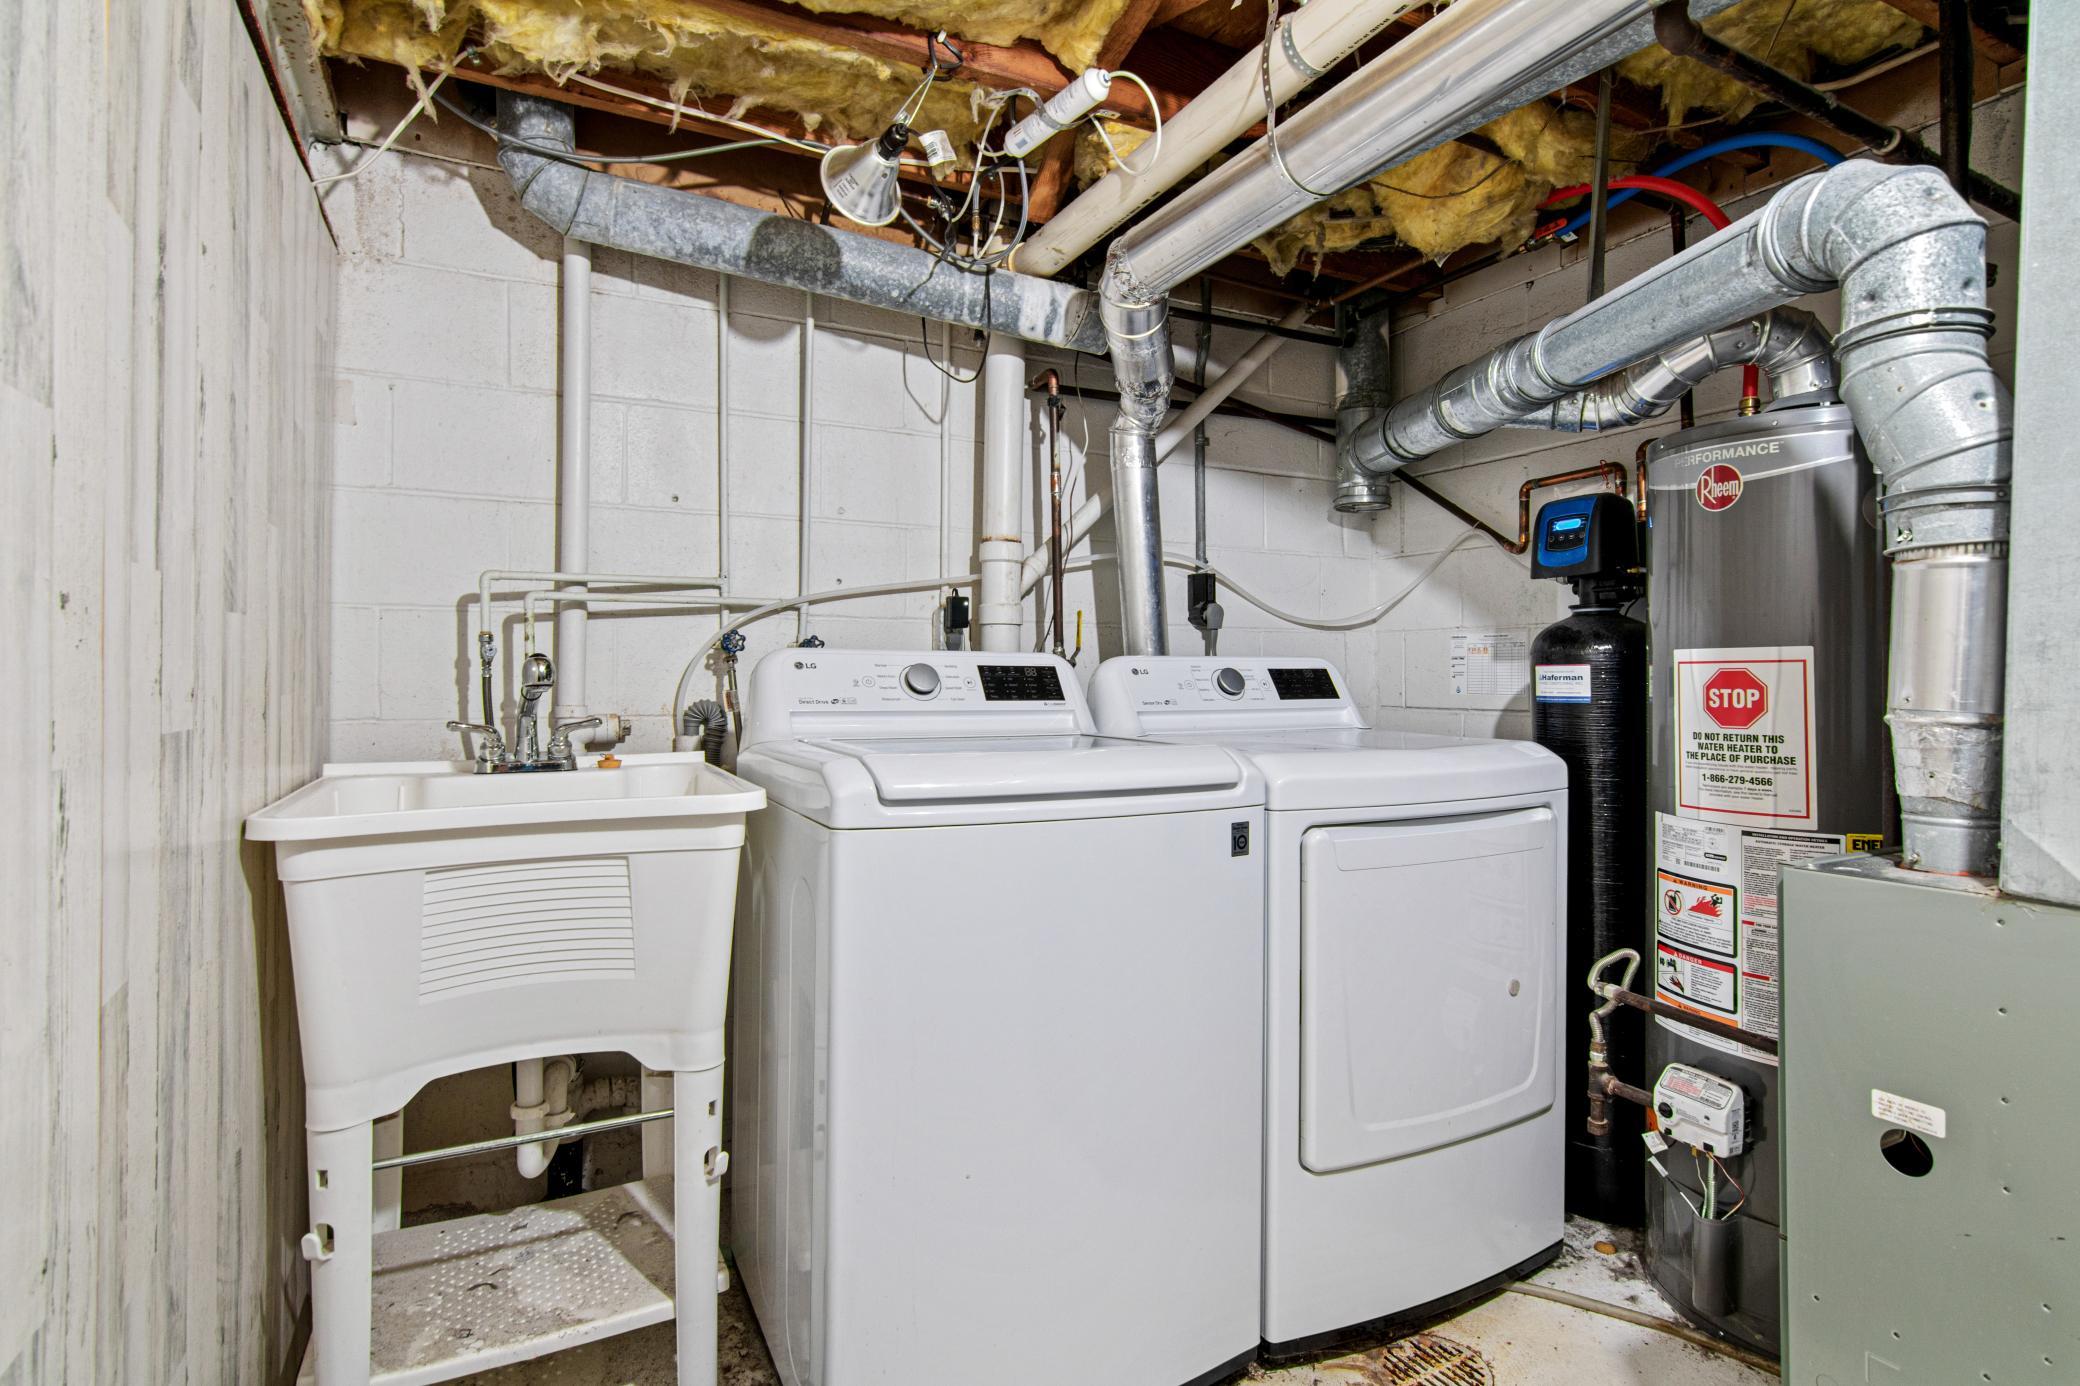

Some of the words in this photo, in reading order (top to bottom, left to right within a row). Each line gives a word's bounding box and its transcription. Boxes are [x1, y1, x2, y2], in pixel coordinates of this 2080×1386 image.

[1674, 441, 1780, 467] PERFORMANCE
[1701, 465, 1740, 504] Rheem
[1709, 688, 1760, 709] STOP
[1692, 731, 1702, 741] DO
[1704, 732, 1719, 742] NOT
[1723, 733, 1759, 744] RETURN
[1762, 734, 1785, 744] THIS
[1697, 742, 1725, 752] WATER
[1727, 744, 1762, 754] HEATER
[1766, 745, 1778, 755] TO
[1686, 751, 1699, 761] THE
[1700, 752, 1727, 762] PLACE
[1729, 754, 1741, 763] OF
[1744, 755, 1797, 766] PURCHASE
[1702, 773, 1773, 787] 1-866-279-4566
[1680, 879, 1708, 891] WARNING
[1678, 952, 1702, 965] DANGER
